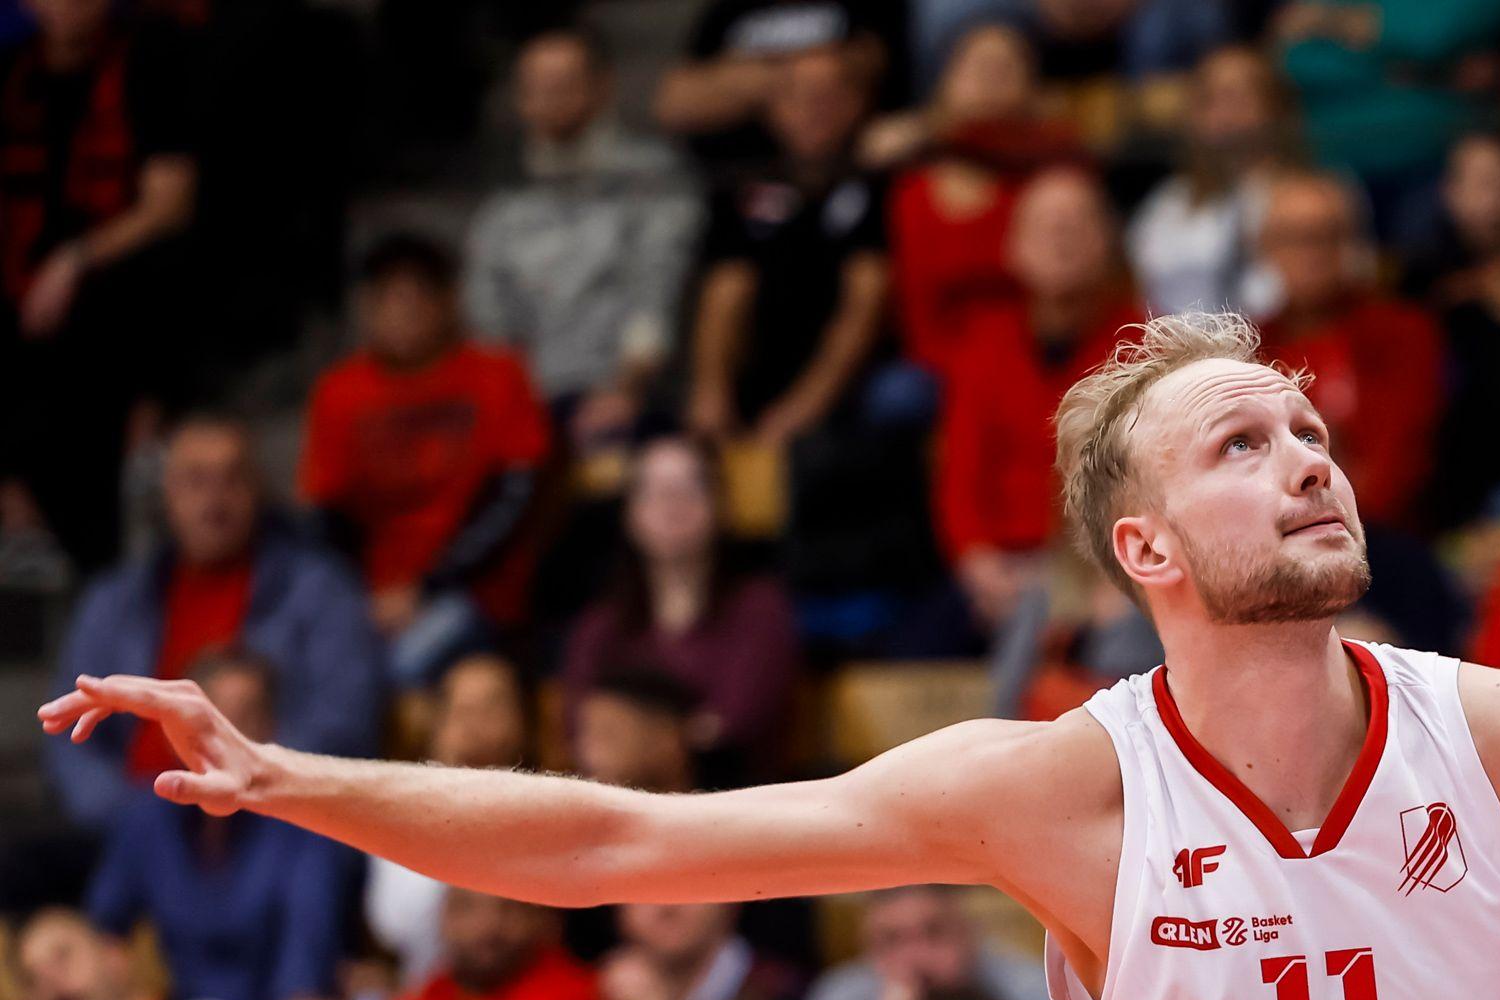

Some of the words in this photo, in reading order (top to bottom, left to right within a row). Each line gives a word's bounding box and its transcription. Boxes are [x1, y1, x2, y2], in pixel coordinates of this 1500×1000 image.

[1157, 922, 1213, 945] ORLEN
[1251, 914, 1293, 929] Basket
[1253, 929, 1279, 943] Liga
